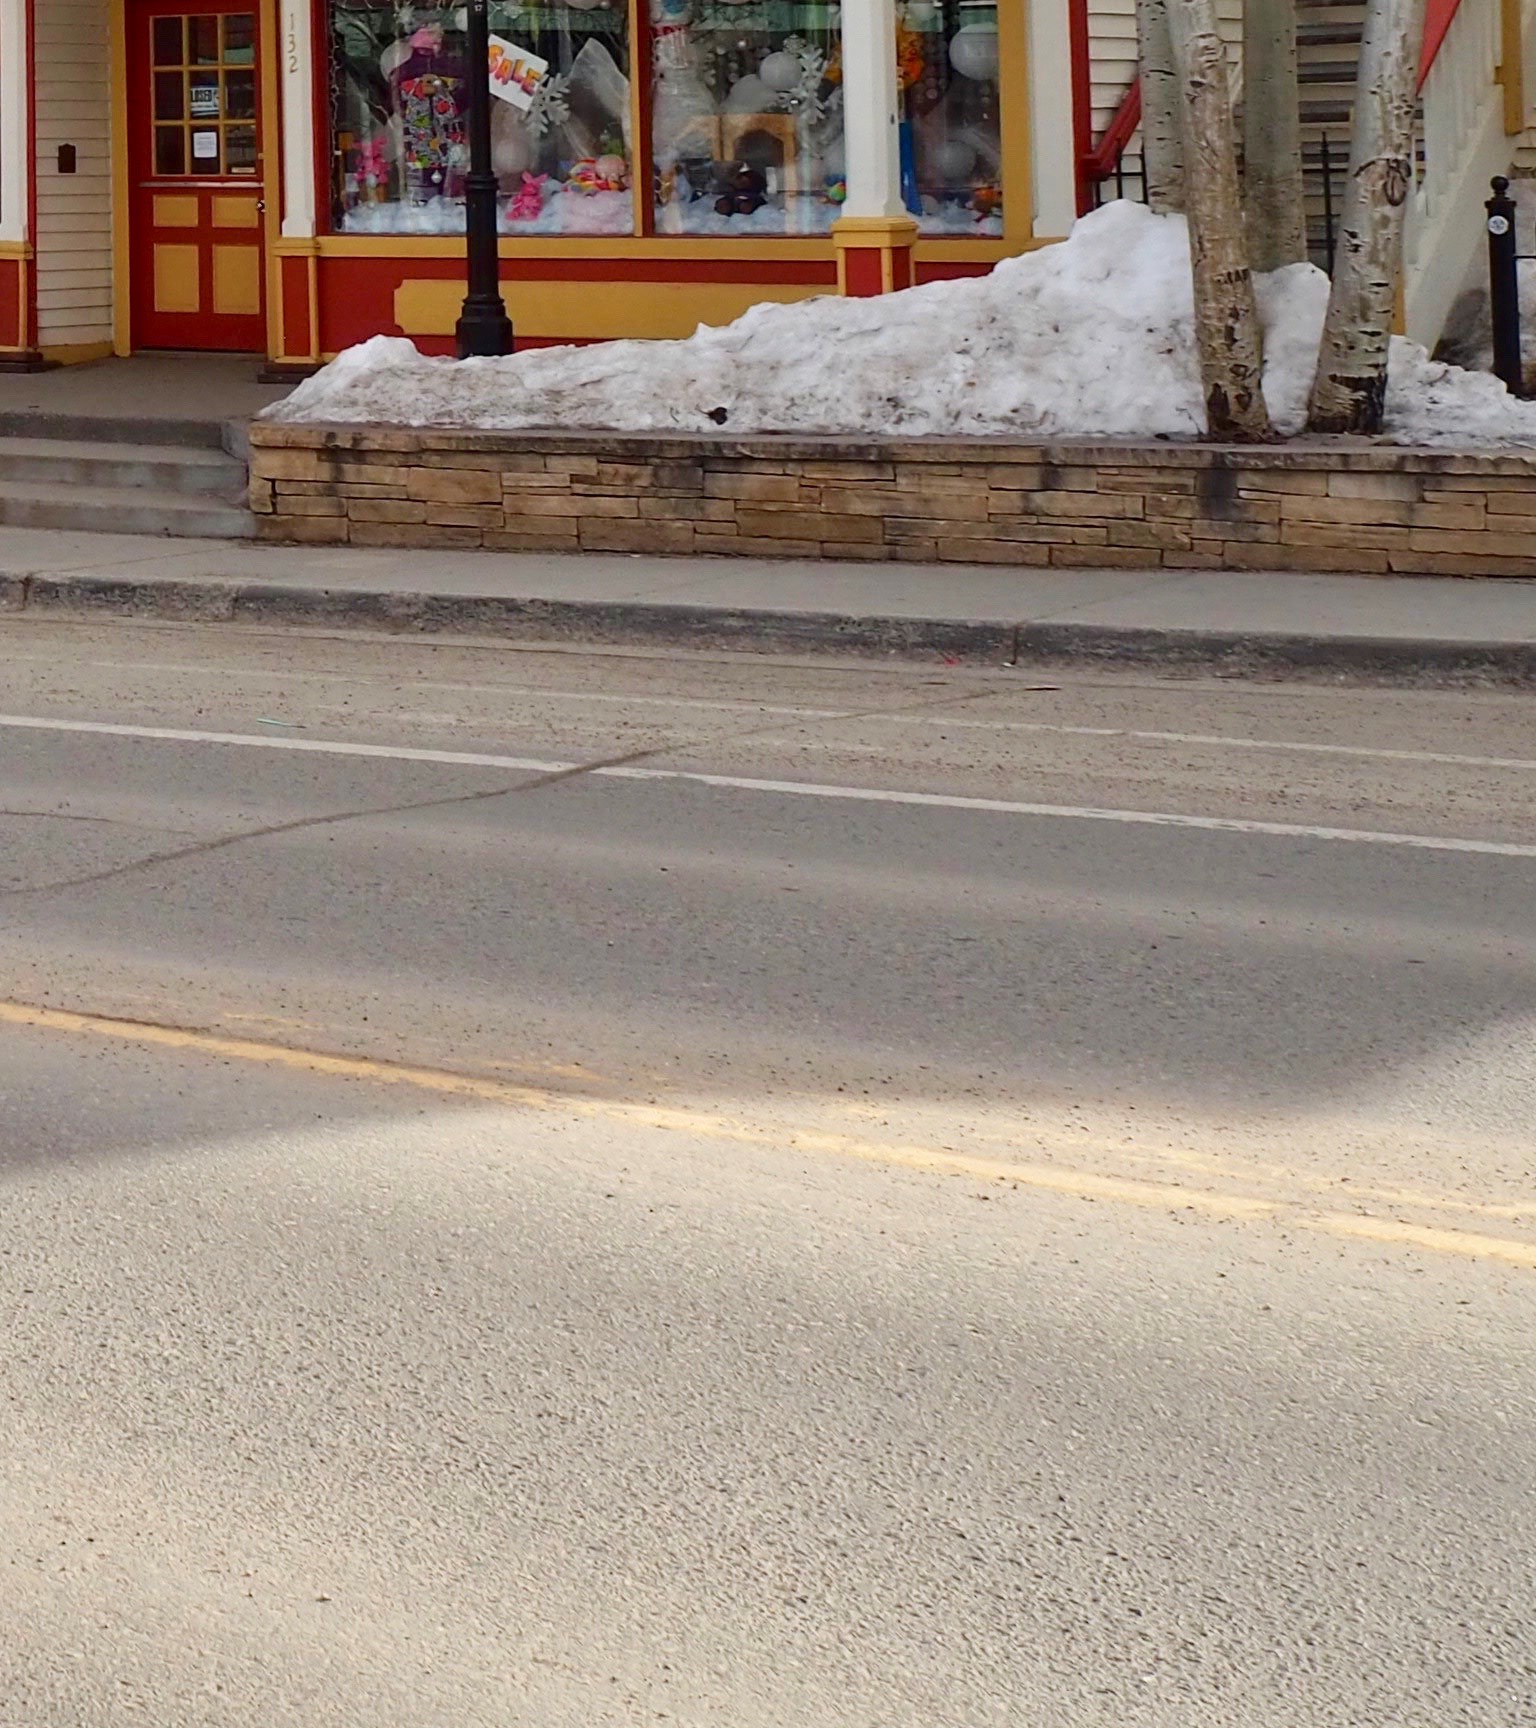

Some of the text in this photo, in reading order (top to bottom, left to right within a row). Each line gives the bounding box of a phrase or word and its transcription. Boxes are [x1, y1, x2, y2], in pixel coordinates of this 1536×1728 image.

[287, 13, 298, 73] 132
[191, 89, 213, 102] LOSED
[488, 44, 542, 97] SALE
